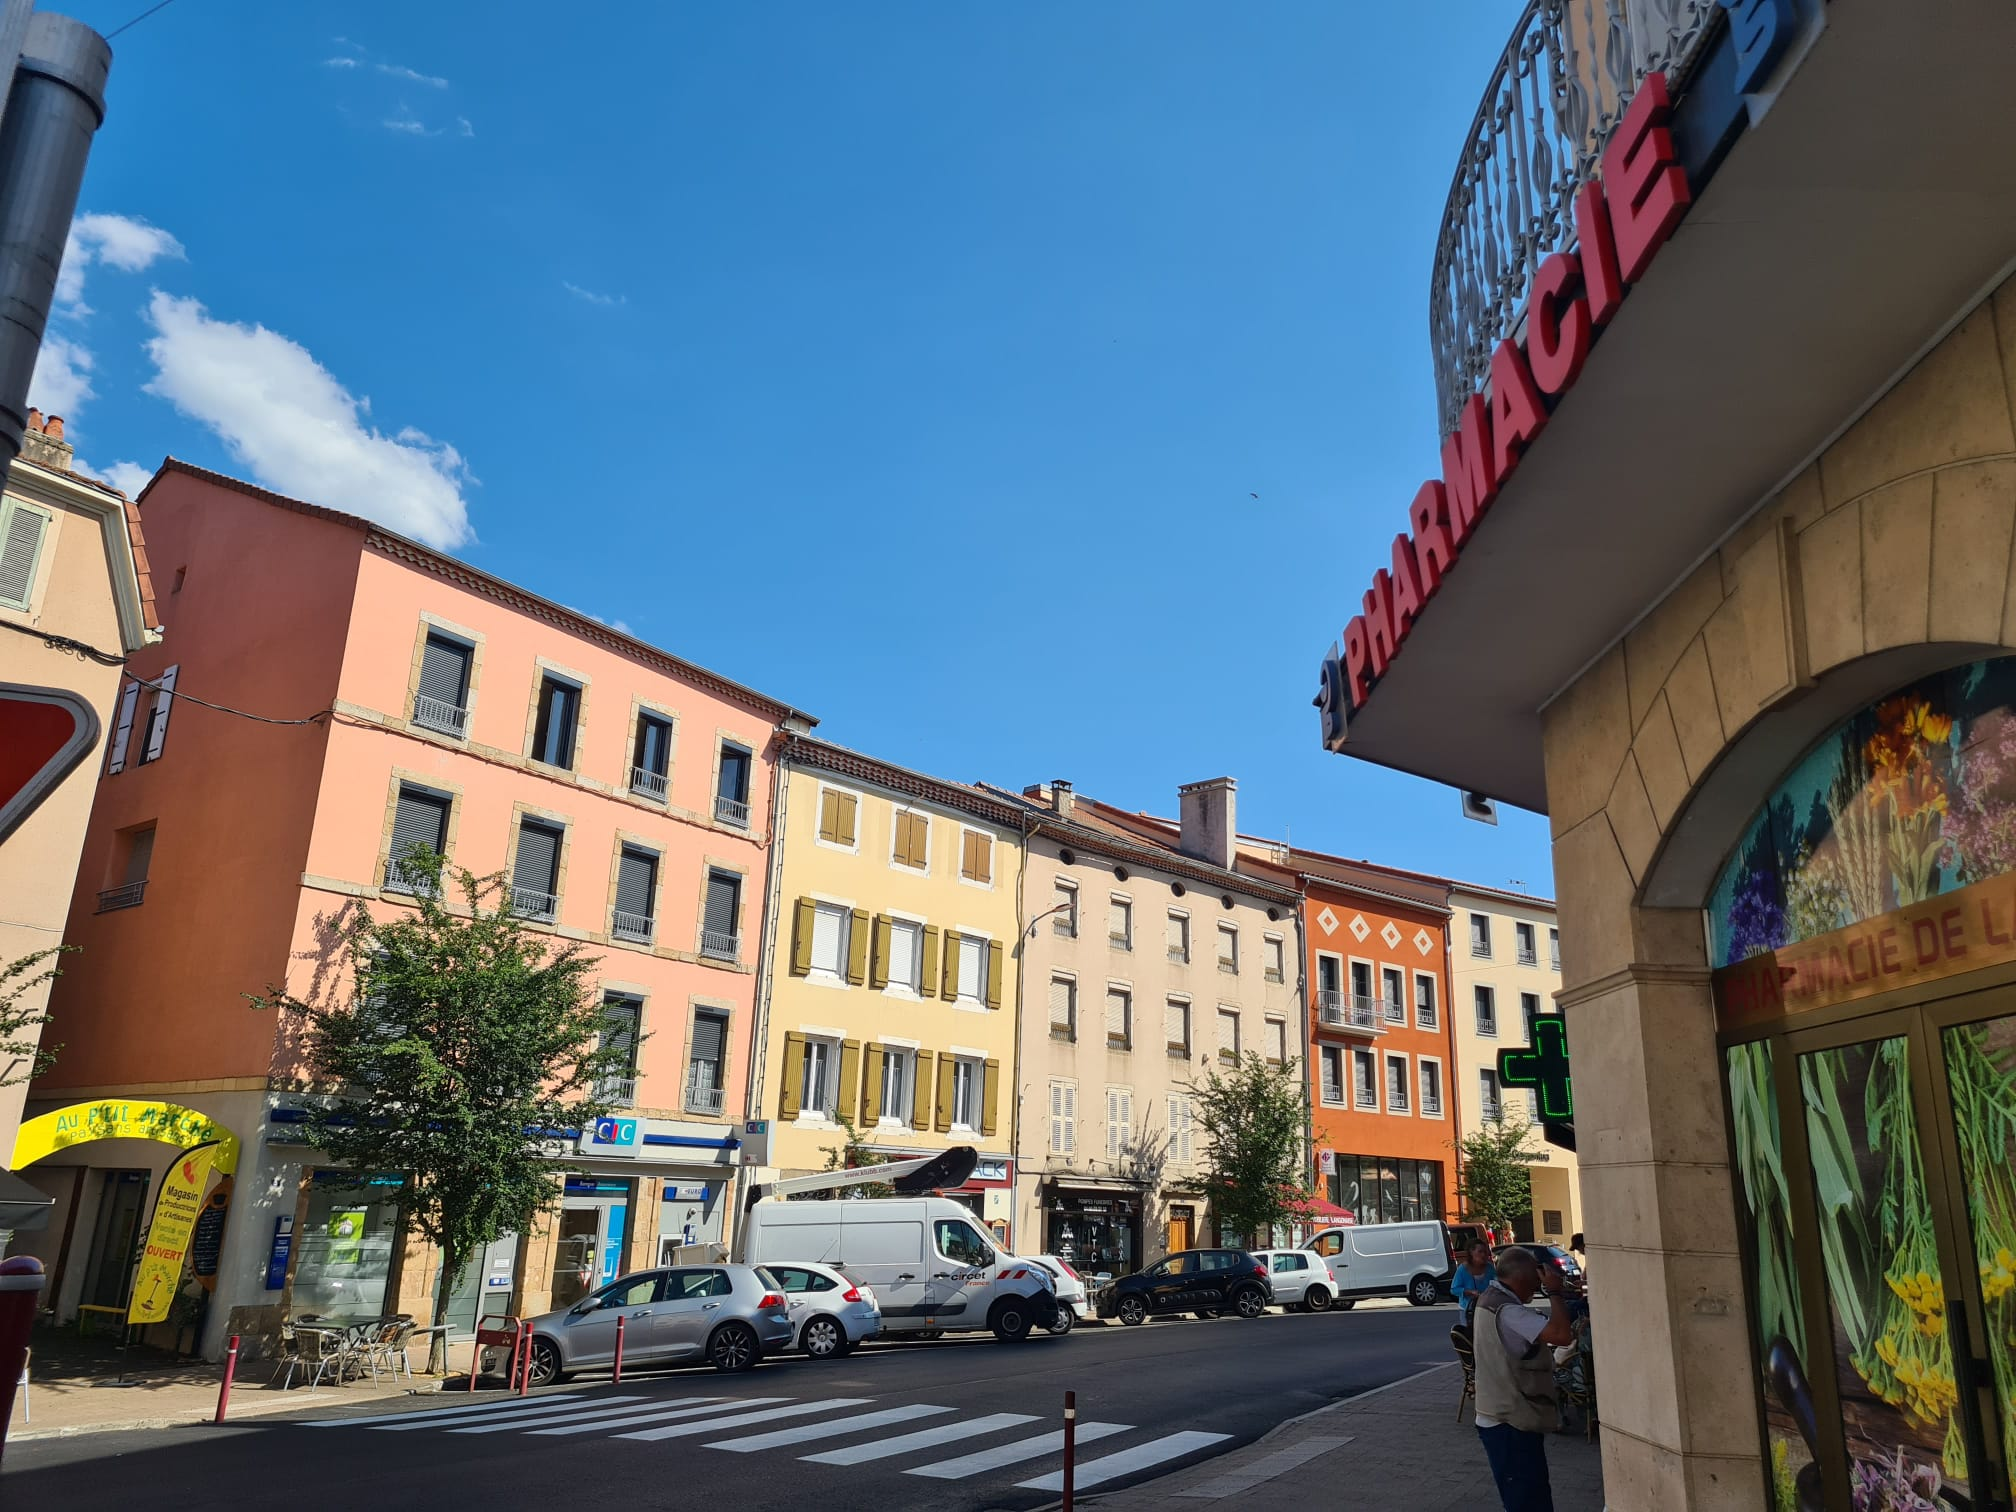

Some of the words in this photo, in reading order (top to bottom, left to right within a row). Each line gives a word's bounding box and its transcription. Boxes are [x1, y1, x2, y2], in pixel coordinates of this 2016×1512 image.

[1343, 71, 1691, 709] PHARMACIE
[1723, 928, 1903, 1013] PHARMACIE
[1912, 907, 1968, 966] DE
[1981, 891, 2016, 946] L
[56, 1112, 79, 1133] Au
[140, 1106, 215, 1141] Marché
[70, 1121, 131, 1142] paysans
[598, 1121, 634, 1142] CIC
[746, 1122, 766, 1134] CIC
[975, 1161, 1005, 1178] ACK
[166, 1185, 199, 1201] Magasin
[146, 1245, 184, 1262] OUVERT
[951, 1271, 986, 1281] circet
